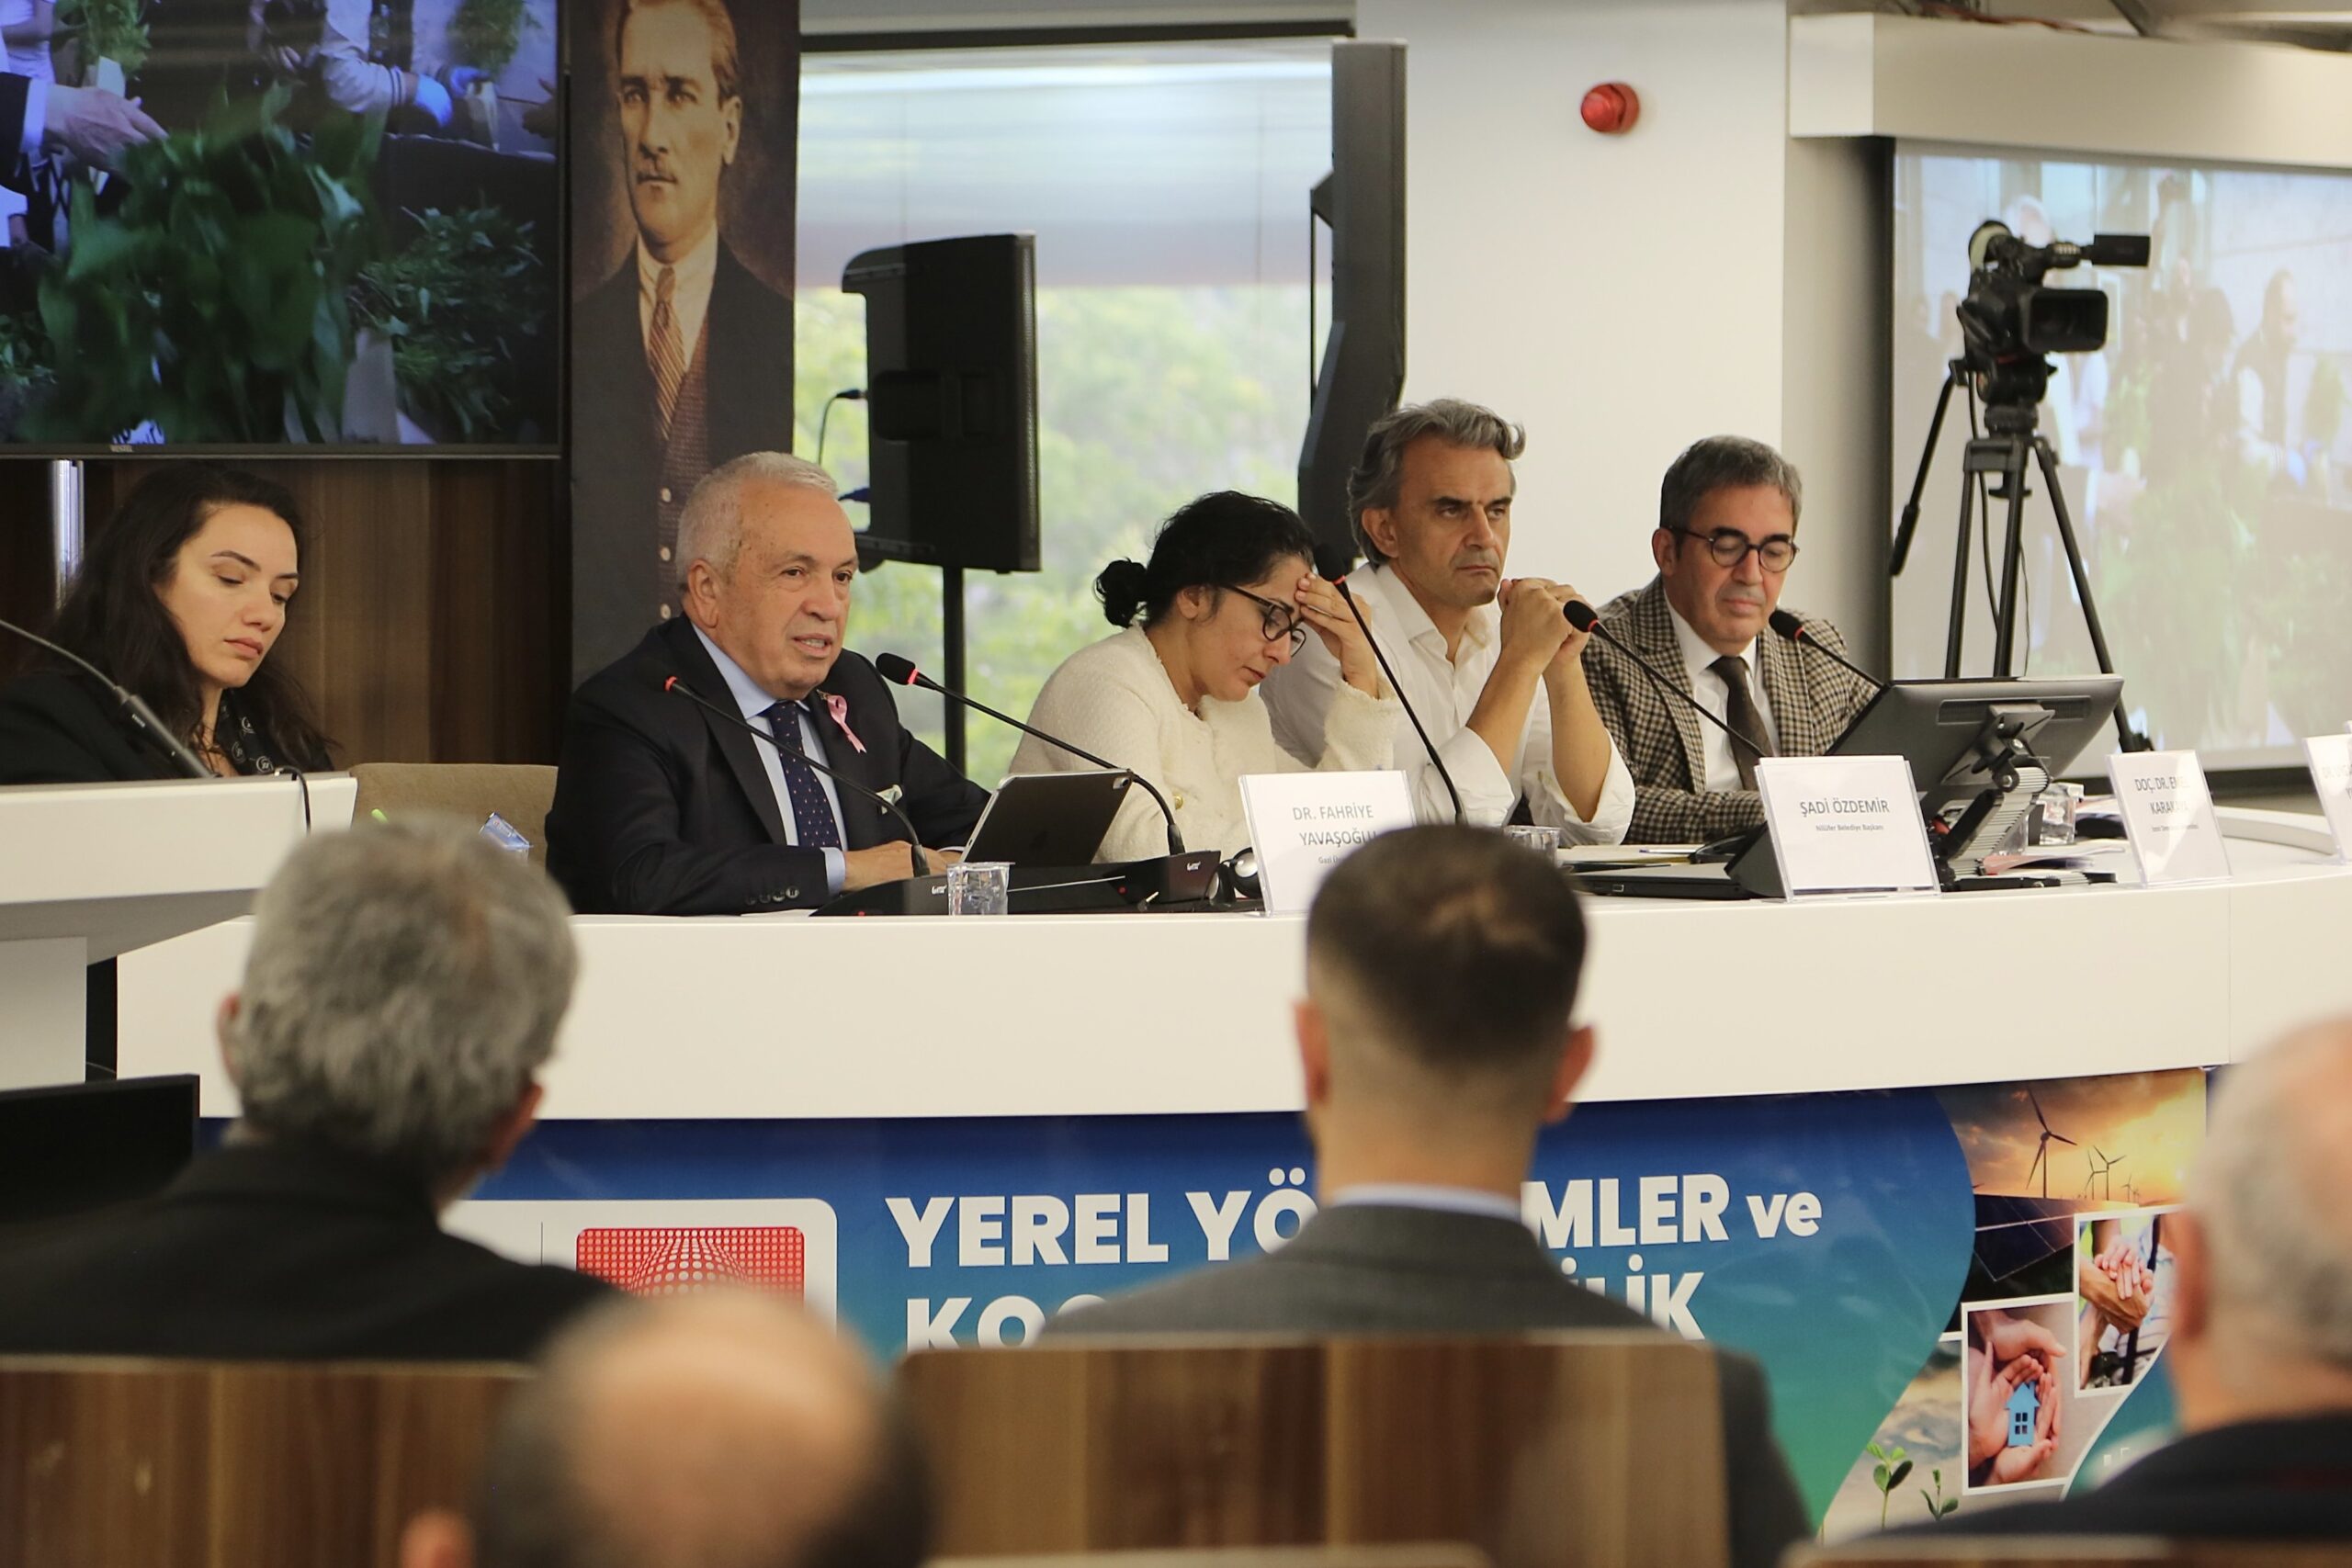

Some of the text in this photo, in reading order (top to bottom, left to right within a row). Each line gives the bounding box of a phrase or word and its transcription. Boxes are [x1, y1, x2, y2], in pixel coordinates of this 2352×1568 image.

[1293, 803, 1374, 820] DR. FAHRİYE
[1800, 797, 1890, 818] ŞADİ ÖZDEMİR
[885, 1193, 1169, 1268] YEREL
[1746, 1191, 1823, 1238] ve
